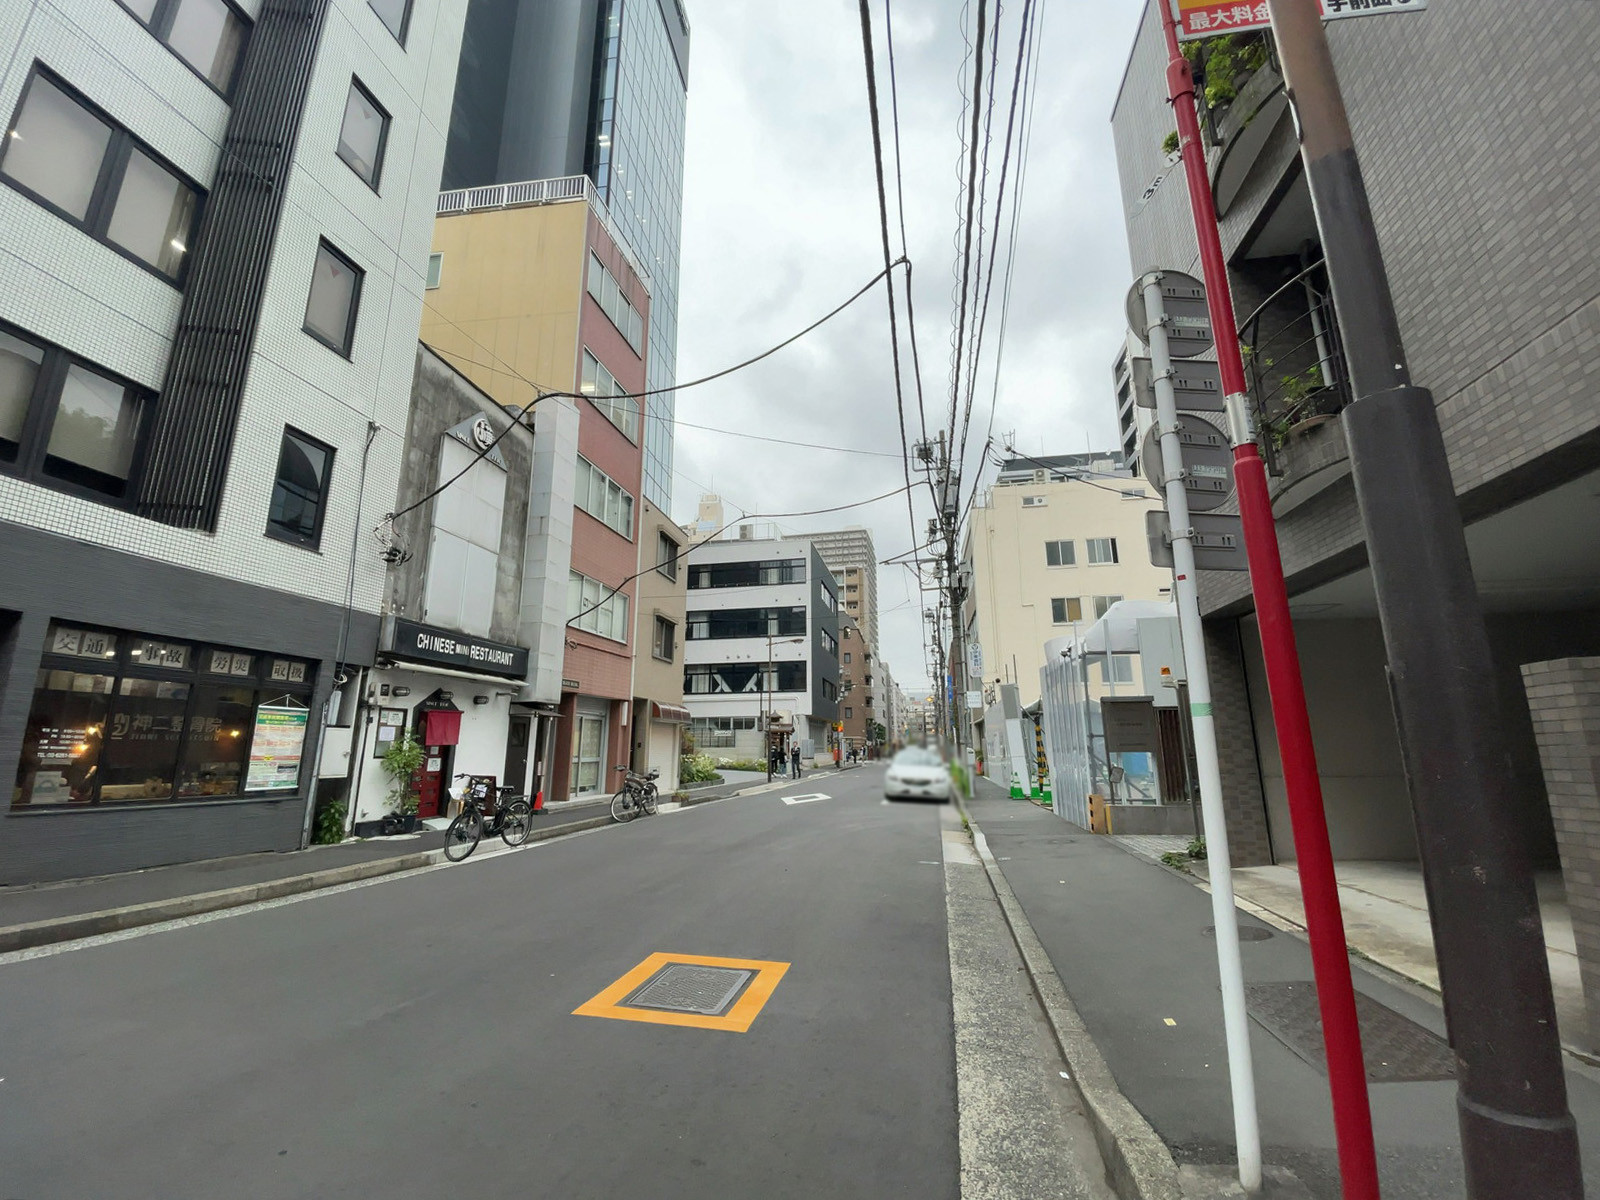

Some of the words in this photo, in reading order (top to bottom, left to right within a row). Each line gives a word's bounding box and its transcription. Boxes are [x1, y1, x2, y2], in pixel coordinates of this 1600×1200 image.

[1189, 3, 1270, 30] 最大料金
[57, 633, 104, 655] 交通
[144, 643, 183, 666] 事故
[214, 656, 248, 672] 労災
[417, 633, 455, 655] CHINESE
[455, 643, 470, 656] MINI
[470, 645, 514, 666] RESTAURANT
